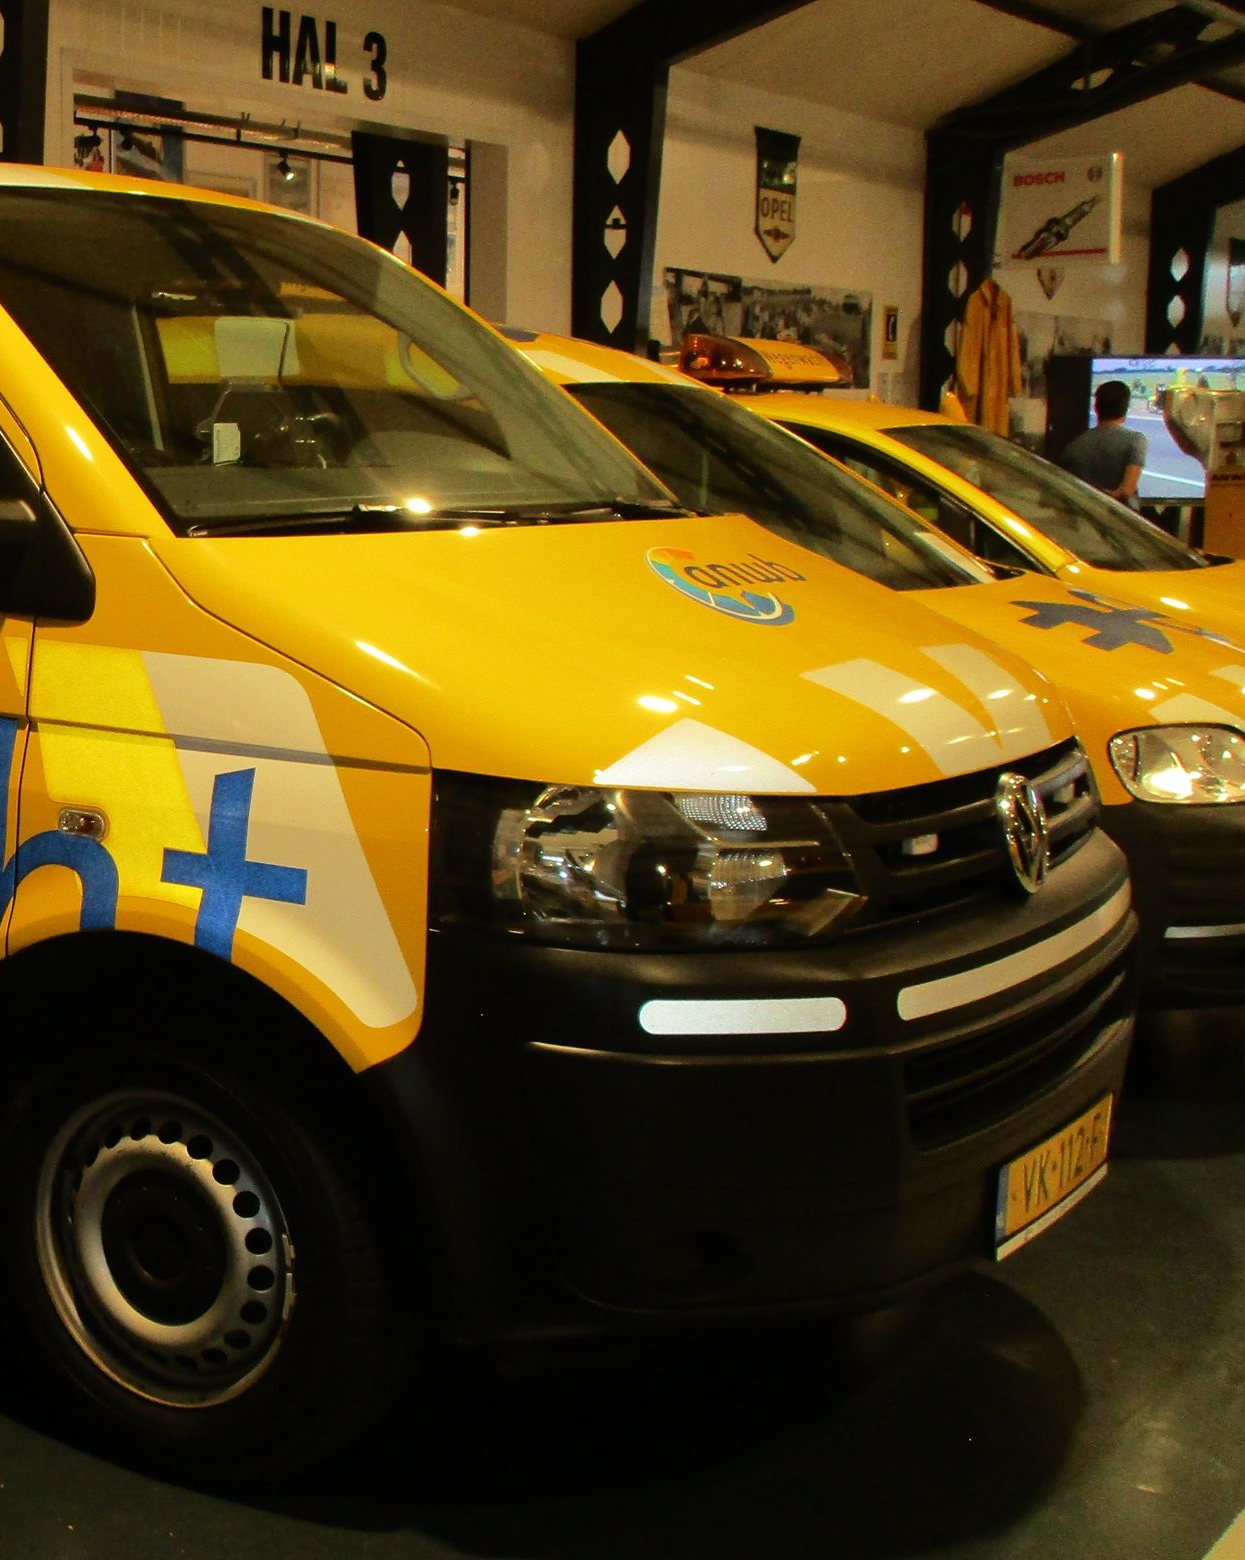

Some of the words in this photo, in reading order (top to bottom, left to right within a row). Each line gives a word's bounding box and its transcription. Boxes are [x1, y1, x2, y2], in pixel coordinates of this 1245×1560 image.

[261, 6, 348, 95] HAL
[362, 31, 387, 101] 3
[1012, 171, 1066, 188] BOSCH
[760, 196, 793, 222] OPEL
[683, 553, 807, 589] anwb
